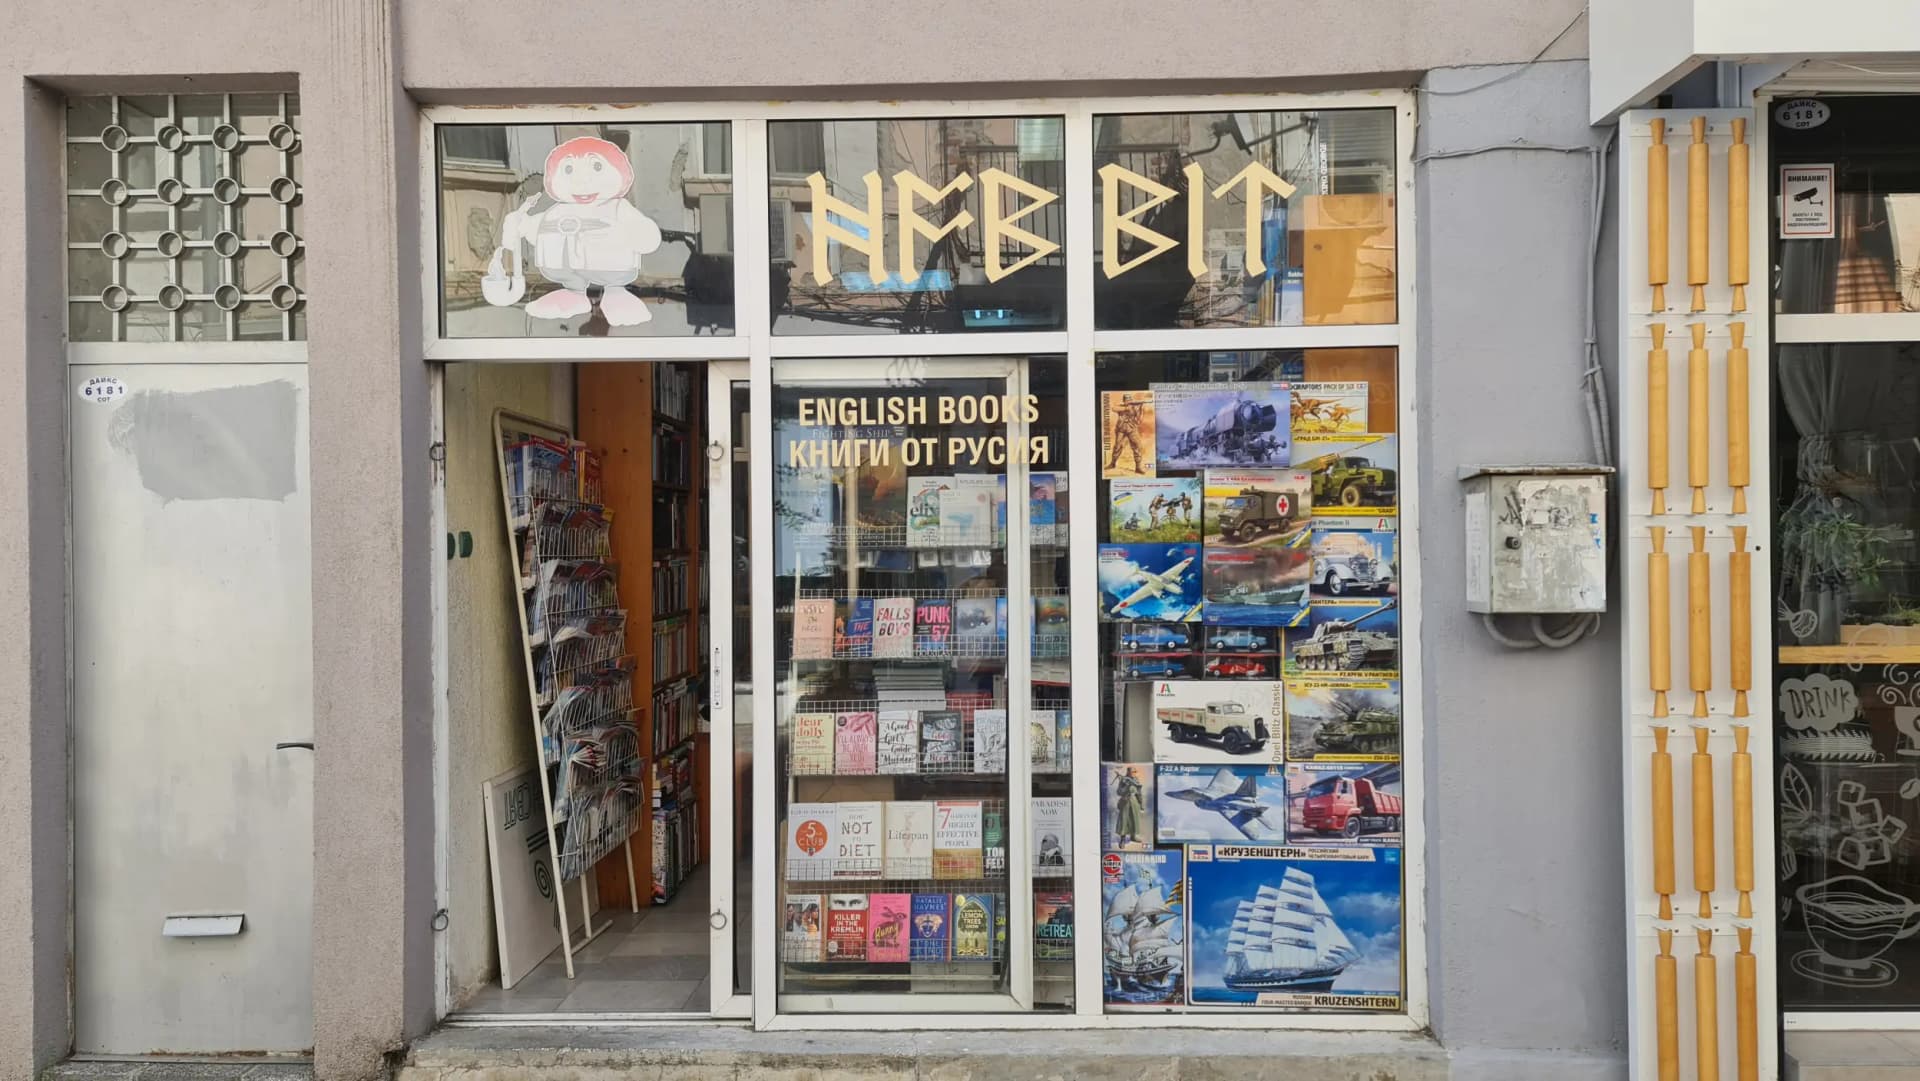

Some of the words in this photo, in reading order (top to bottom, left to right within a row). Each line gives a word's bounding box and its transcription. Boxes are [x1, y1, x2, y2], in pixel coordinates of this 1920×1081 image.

[85, 385, 123, 396] 6181
[798, 396, 927, 426] ENGLISH
[937, 394, 1039, 425] BOOKS
[789, 438, 890, 468] КНИГИ
[900, 437, 938, 467] ОТ
[948, 436, 1049, 466] РУСИЯ
[876, 607, 912, 621] FALLS
[916, 606, 951, 624] PUNK
[878, 622, 911, 636] BOYS
[931, 625, 951, 641] 57
[1272, 683, 1281, 717] Classic
[1786, 686, 1852, 719] DRINK
[1272, 719, 1281, 739] Blitz
[1272, 742, 1281, 762] Opel
[939, 807, 952, 831] 7
[806, 822, 817, 838] 5
[841, 821, 873, 835] NOT
[798, 838, 824, 846] CLUB
[887, 829, 929, 842] Lifespan
[840, 844, 876, 857] DIET
[1217, 847, 1307, 859] «КРУЗЕНШТЕРН»
[834, 913, 861, 921] KILLER
[961, 910, 984, 919] LEMON
[1314, 996, 1397, 1008] KRUZENSHTERN
